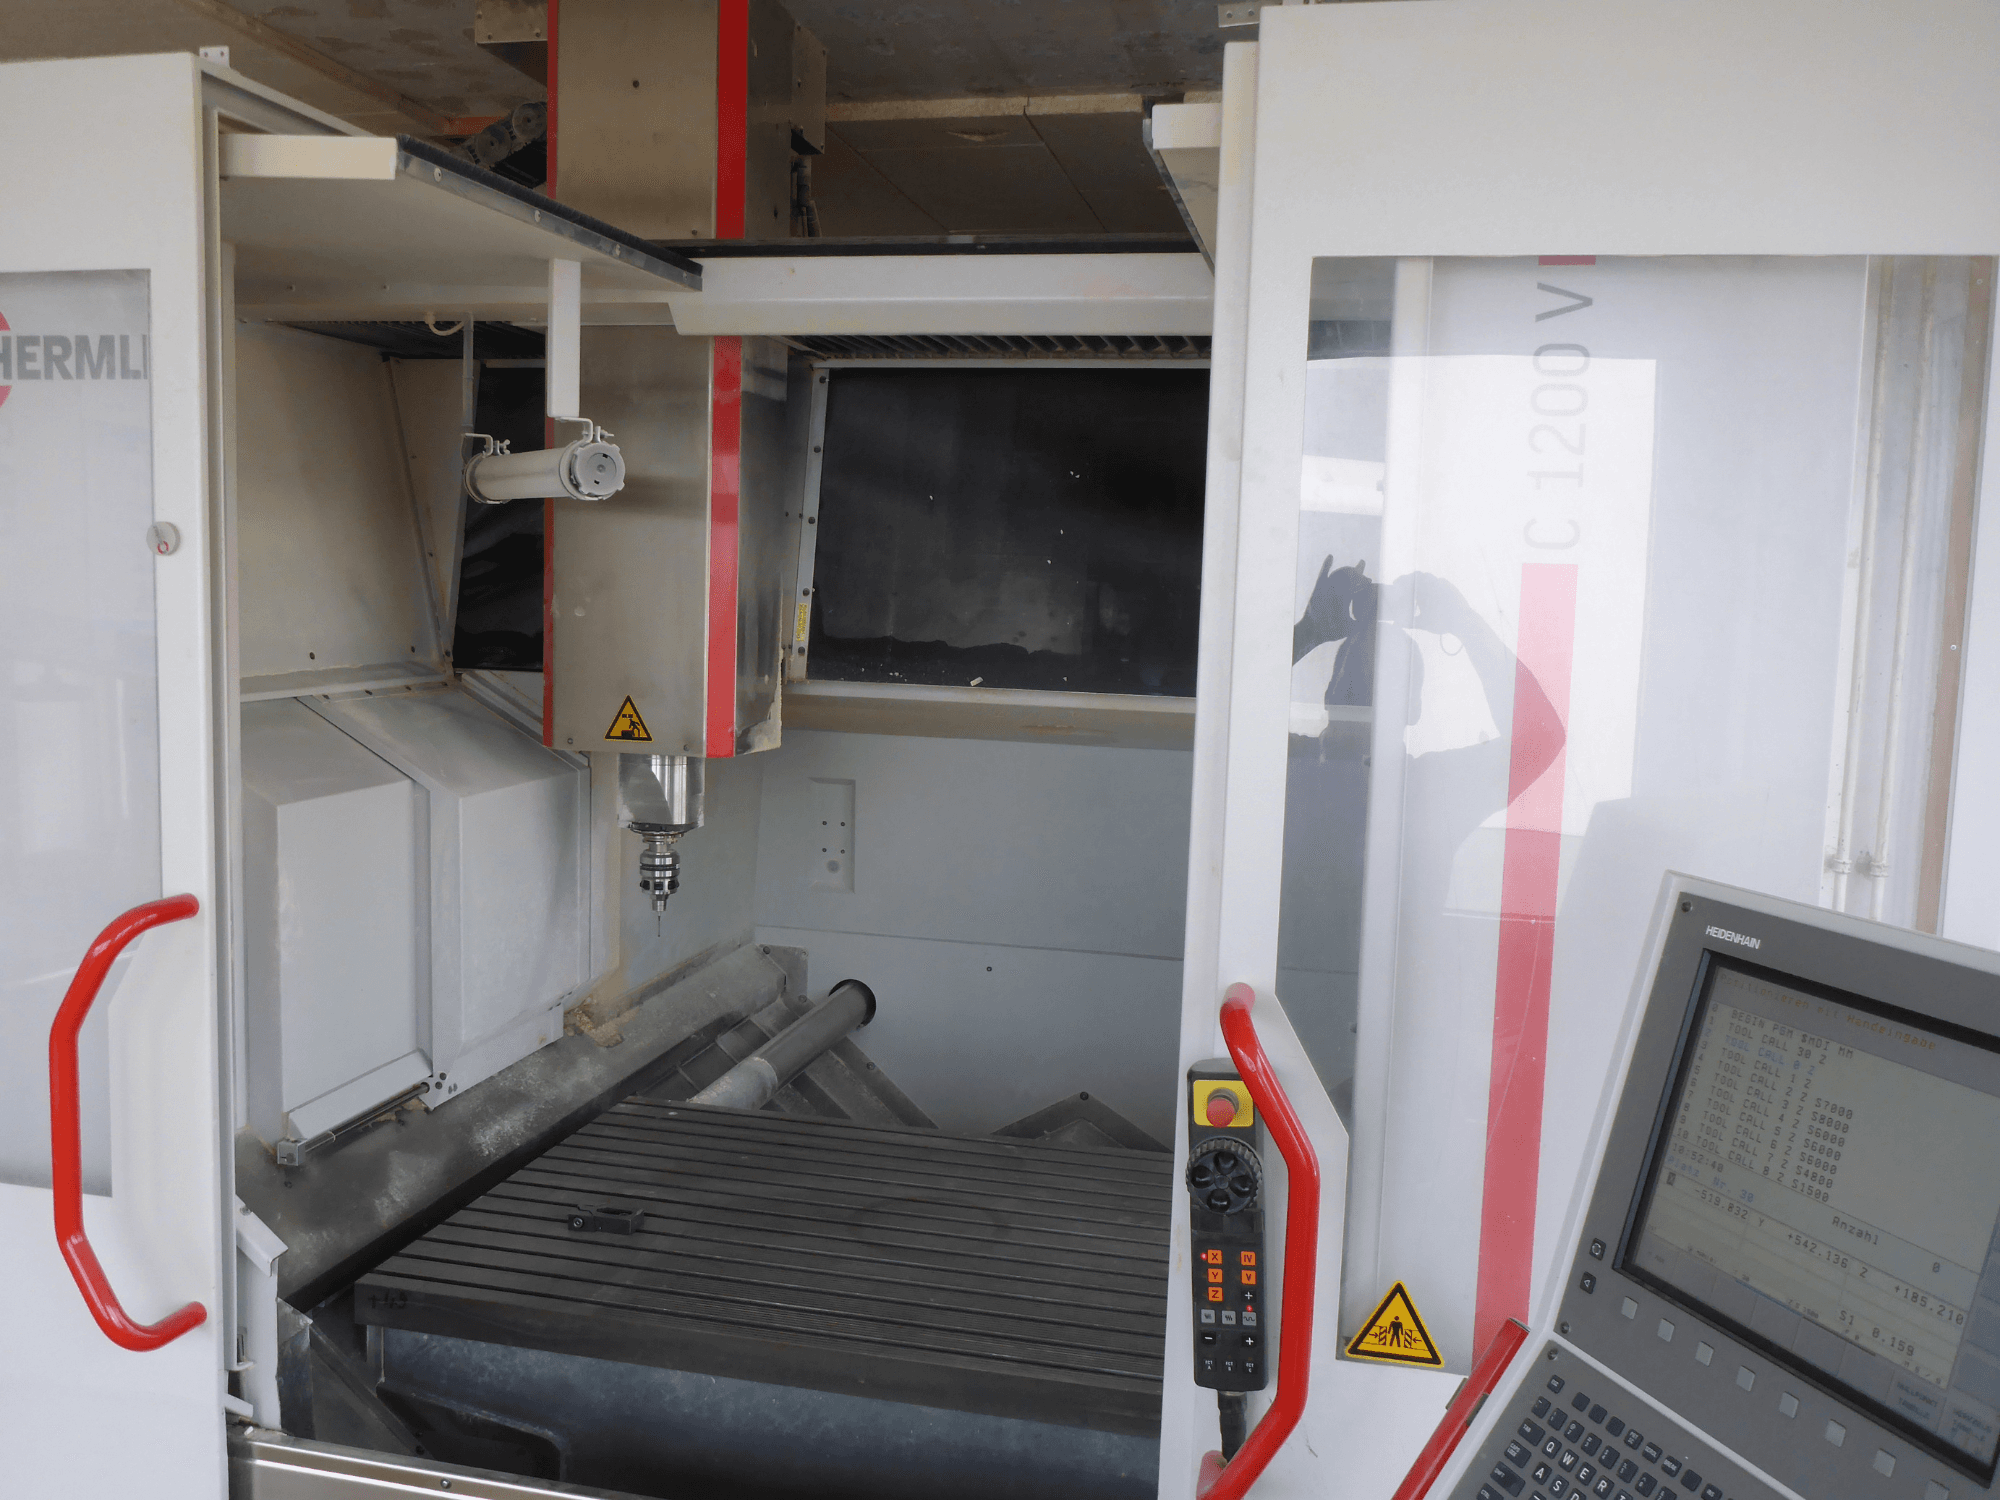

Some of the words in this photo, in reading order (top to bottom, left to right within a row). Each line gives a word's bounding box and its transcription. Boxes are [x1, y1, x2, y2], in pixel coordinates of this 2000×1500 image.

[1534, 282, 1594, 323] V
[1526, 342, 1591, 491] 1200
[1523, 517, 1581, 550] C
[1705, 925, 1760, 949] HEIDENHAIN
[1723, 1034, 1751, 1052] TOOL
[1757, 1046, 1785, 1065] CALL
[1792, 1059, 1800, 1070] 0
[1806, 1064, 1815, 1075] Z
[1726, 1022, 1754, 1039] TOOL
[1760, 1033, 1789, 1052] CALL
[1796, 1046, 1811, 1059] 30
[1818, 1053, 1827, 1065] Z
[1730, 1009, 1765, 1029] BEGIN
[1771, 1023, 1794, 1039] PGM
[1800, 1032, 1830, 1051] $MDI
[1837, 1045, 1854, 1059] MM
[1719, 1047, 1747, 1065] TOOL
[1753, 1059, 1782, 1078] CALL
[1788, 1072, 1797, 1084] 1
[1803, 1077, 1811, 1089] Z
[1712, 1072, 1740, 1091] TOOL
[1746, 1085, 1774, 1104] CALL
[1781, 1099, 1789, 1110] 3
[1795, 1104, 1804, 1116] Z
[1810, 1110, 1850, 1134] S8000
[1716, 1060, 1743, 1078] TOOL
[1749, 1072, 1778, 1091] CALL
[1785, 1085, 1793, 1097] 2
[1799, 1091, 1807, 1102] Z
[1814, 1096, 1854, 1120] S7000
[1705, 1098, 1733, 1117] TOOL
[1738, 1111, 1767, 1131] CALL
[1773, 1125, 1782, 1137] 5
[1787, 1131, 1796, 1143] Z
[1802, 1137, 1842, 1162] S6000
[1709, 1085, 1736, 1104] TOOL
[1742, 1098, 1770, 1118] CALL
[1777, 1112, 1785, 1124] 4
[1791, 1118, 1800, 1130] Z
[1806, 1123, 1846, 1148] S6000
[1698, 1123, 1725, 1142] TOOL
[1731, 1137, 1759, 1157] CALL
[1766, 1151, 1774, 1163] 7
[1780, 1157, 1788, 1170] Z
[1794, 1163, 1834, 1189] S4800
[1702, 1110, 1729, 1130] TOOL
[1735, 1124, 1763, 1144] CALL
[1770, 1138, 1778, 1150] 6
[1784, 1144, 1792, 1156] Z
[1798, 1150, 1838, 1175] S6000
[1695, 1135, 1722, 1155] TOOL
[1728, 1149, 1756, 1170] CALL
[1762, 1164, 1770, 1177] 8
[1776, 1170, 1785, 1183] Z
[1790, 1177, 1830, 1203] S1500
[1831, 1215, 1880, 1246] Anzahl
[1212, 1253, 1218, 1261] X
[1693, 1185, 1749, 1220] -519.832
[1786, 1230, 1849, 1269] +542.136
[1892, 1282, 1965, 1326] +185.210
[1212, 1289, 1219, 1299] Z
[1245, 1273, 1252, 1282] V
[1838, 1308, 1855, 1326] S1
[1546, 1442, 1555, 1453] Q
[1562, 1452, 1574, 1466] W
[1535, 1467, 1545, 1479] A
[1552, 1480, 1562, 1492] S
[1580, 1467, 1589, 1480] E
[1597, 1480, 1607, 1492] R
